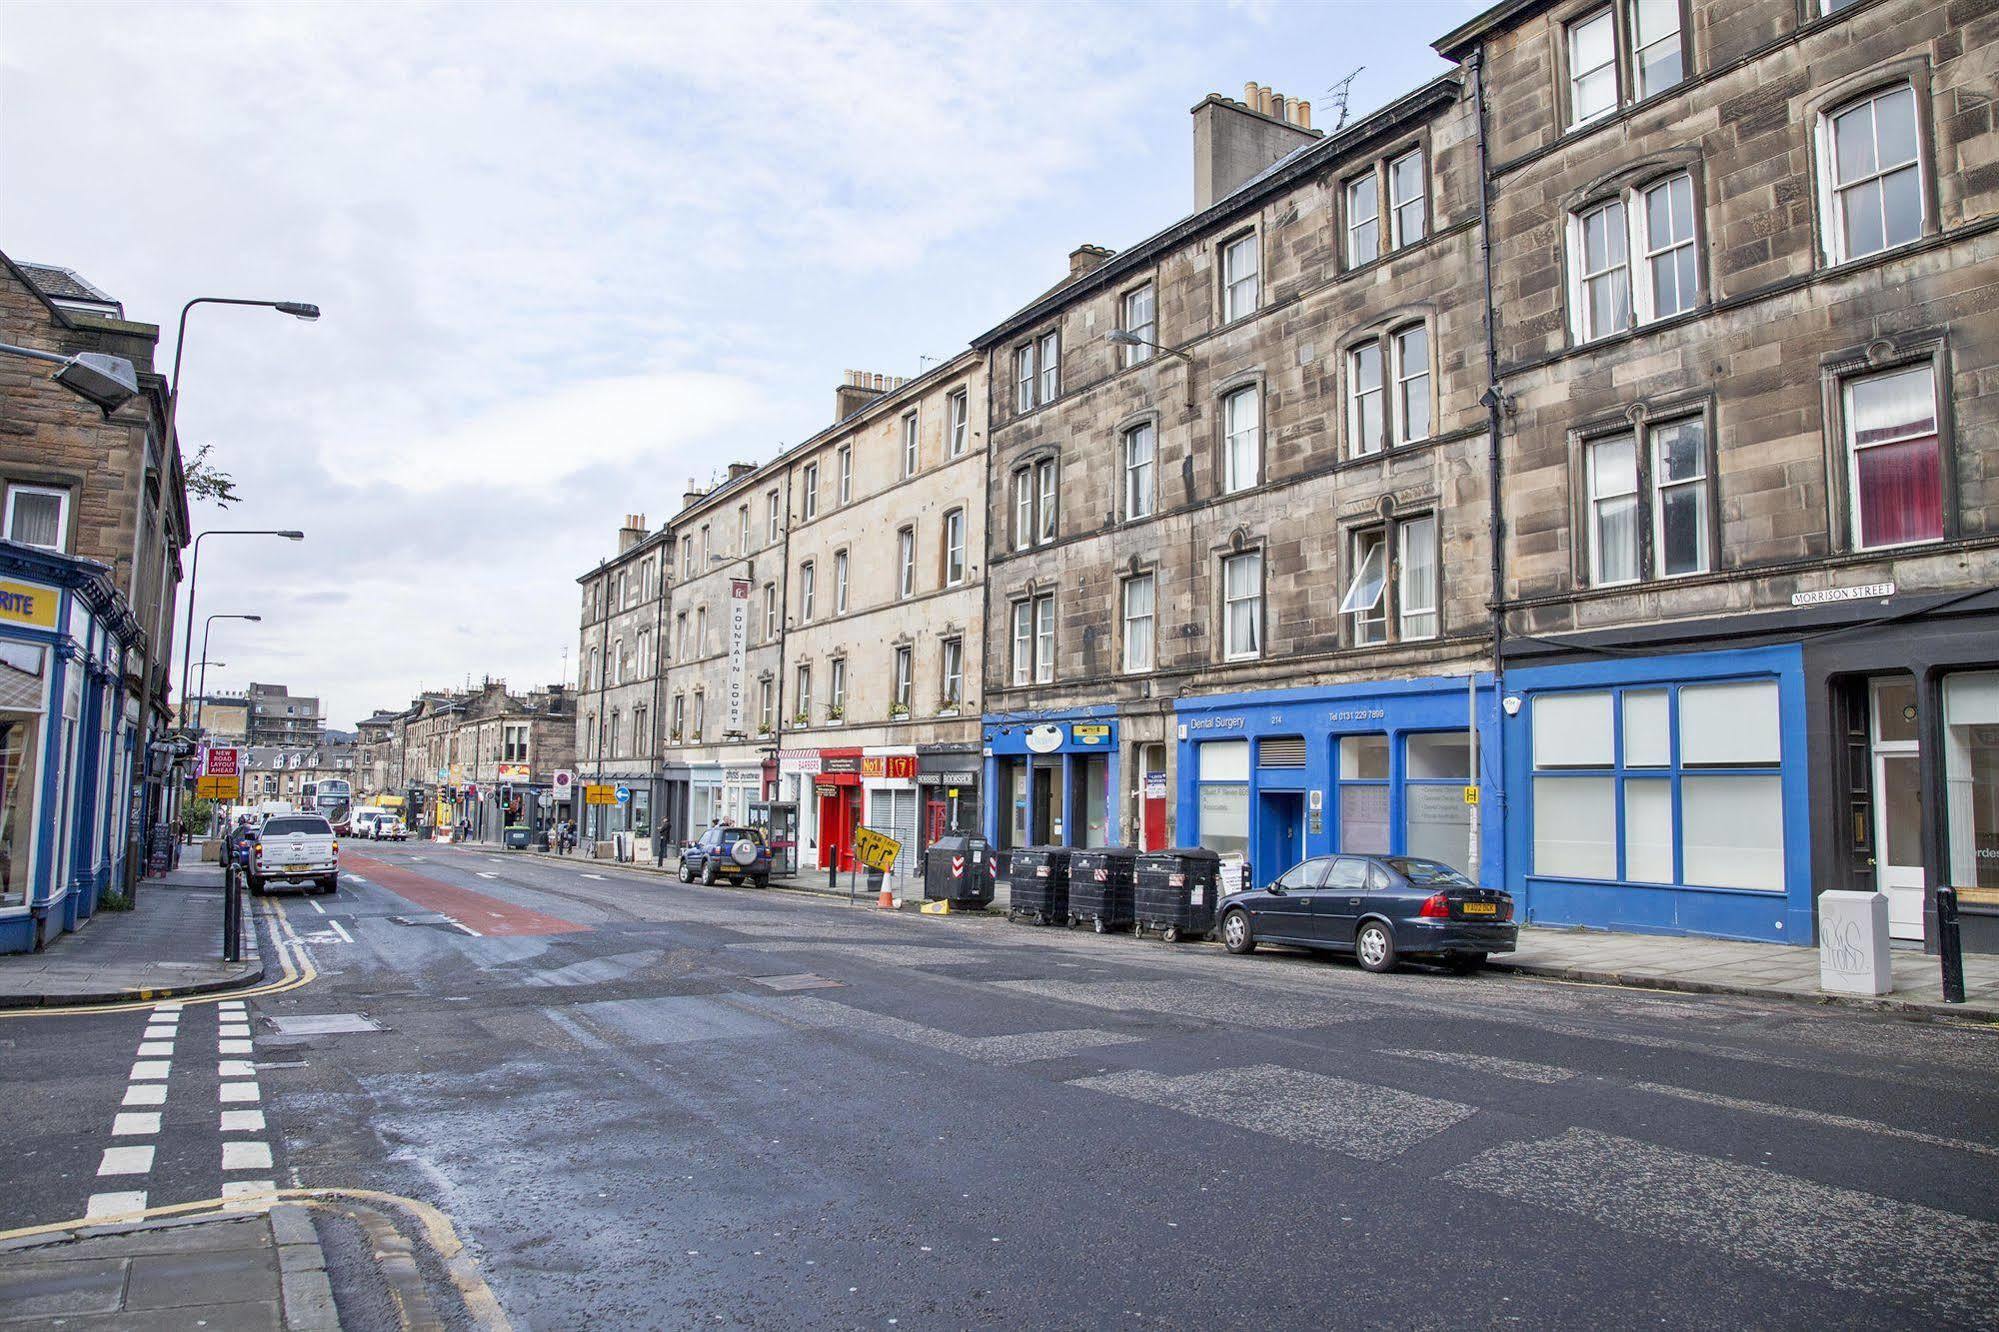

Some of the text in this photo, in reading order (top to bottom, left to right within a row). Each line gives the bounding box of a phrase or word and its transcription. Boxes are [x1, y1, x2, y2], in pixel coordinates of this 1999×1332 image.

[1795, 584, 1892, 603] MORRISON STREET
[731, 607, 743, 723] FOUNTAIN COURT
[1191, 716, 1246, 729] Dental Surgery
[1271, 715, 1282, 725] 214
[1466, 788, 1477, 802] H
